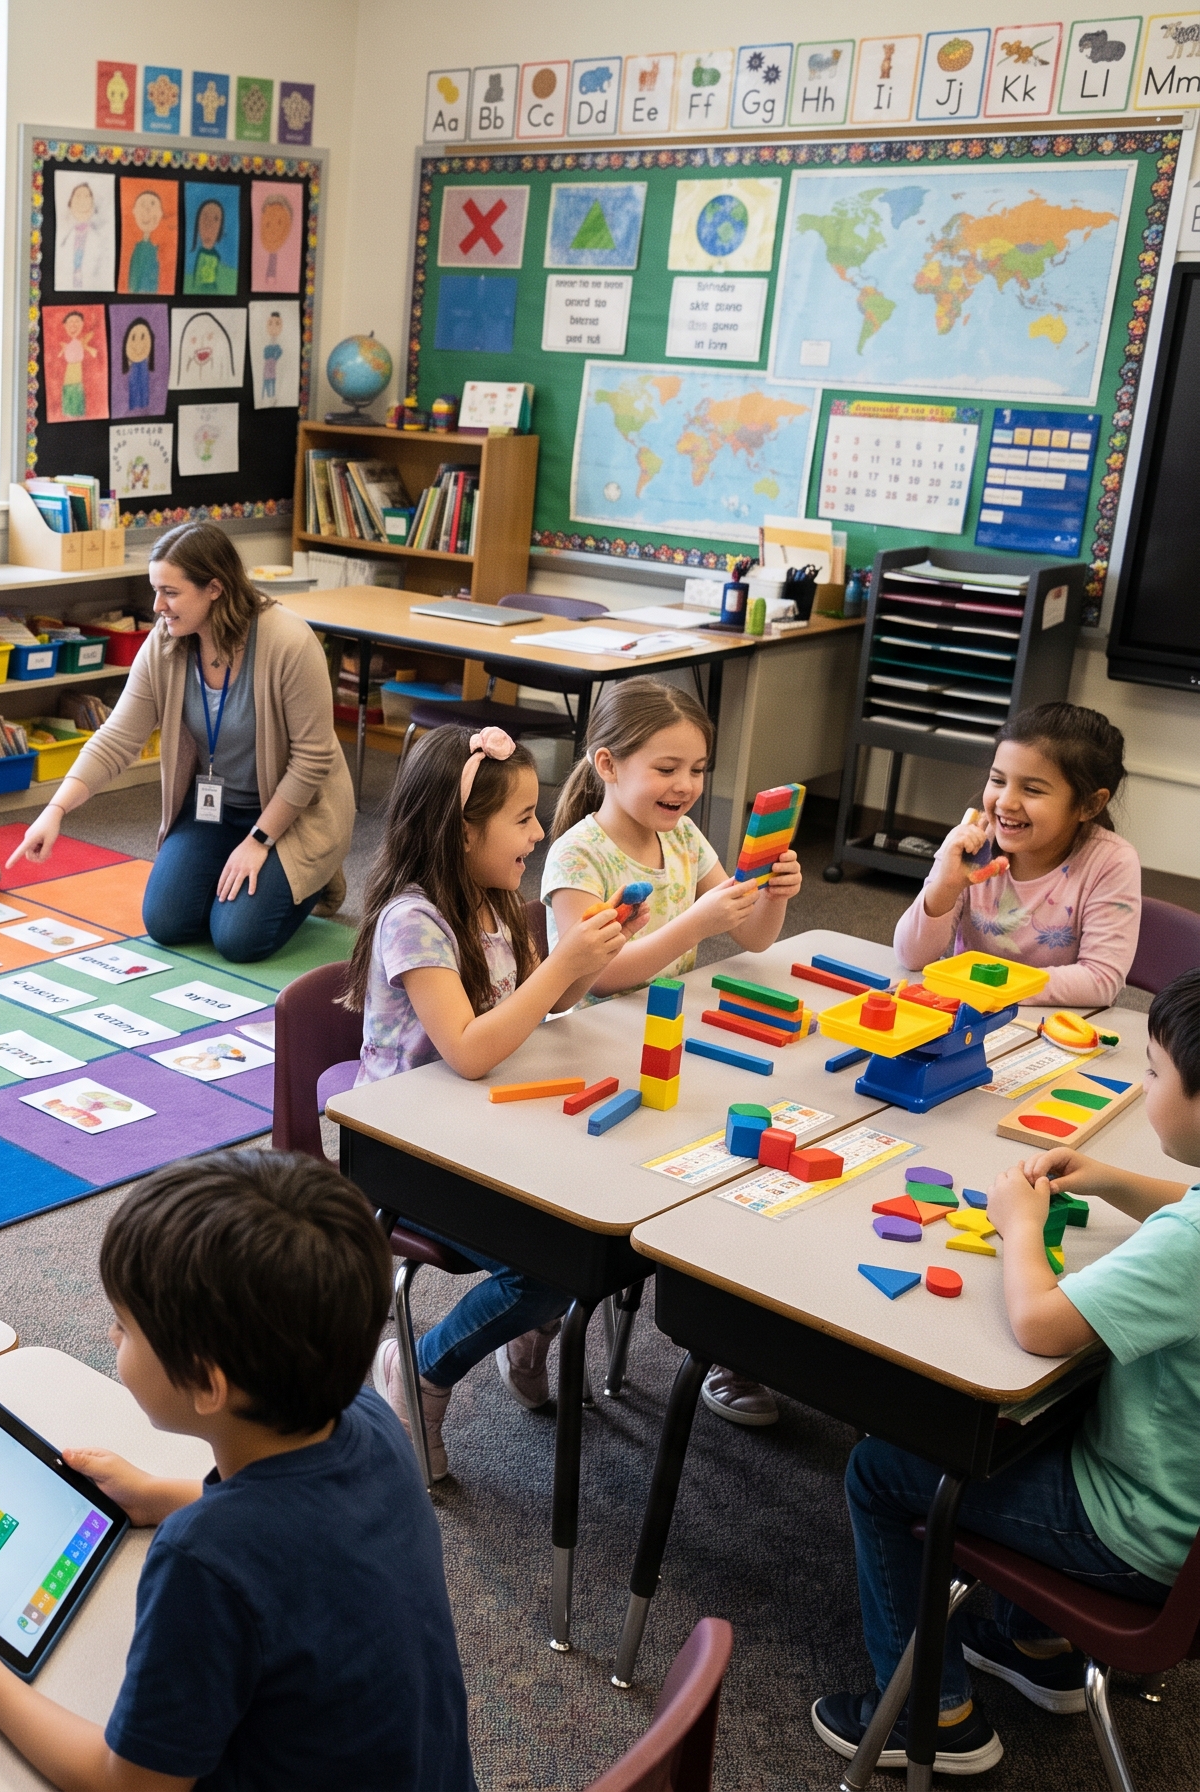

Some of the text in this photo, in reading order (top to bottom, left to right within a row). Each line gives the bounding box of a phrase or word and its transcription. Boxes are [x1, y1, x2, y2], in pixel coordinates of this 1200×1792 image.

[1001, 74, 1037, 103] Kk
[1080, 68, 1110, 99] Ll
[1144, 64, 1200, 96] Mm
[632, 97, 659, 122] Ee
[688, 92, 715, 119] Ff
[741, 89, 776, 124] Gg
[801, 86, 835, 113] Hh
[873, 84, 893, 110] Ii
[935, 78, 963, 115] Jj
[432, 110, 459, 133] Aa
[478, 106, 504, 130] Bb
[527, 104, 555, 127] Cc
[577, 100, 608, 125] Dd
[891, 457, 902, 466] 12
